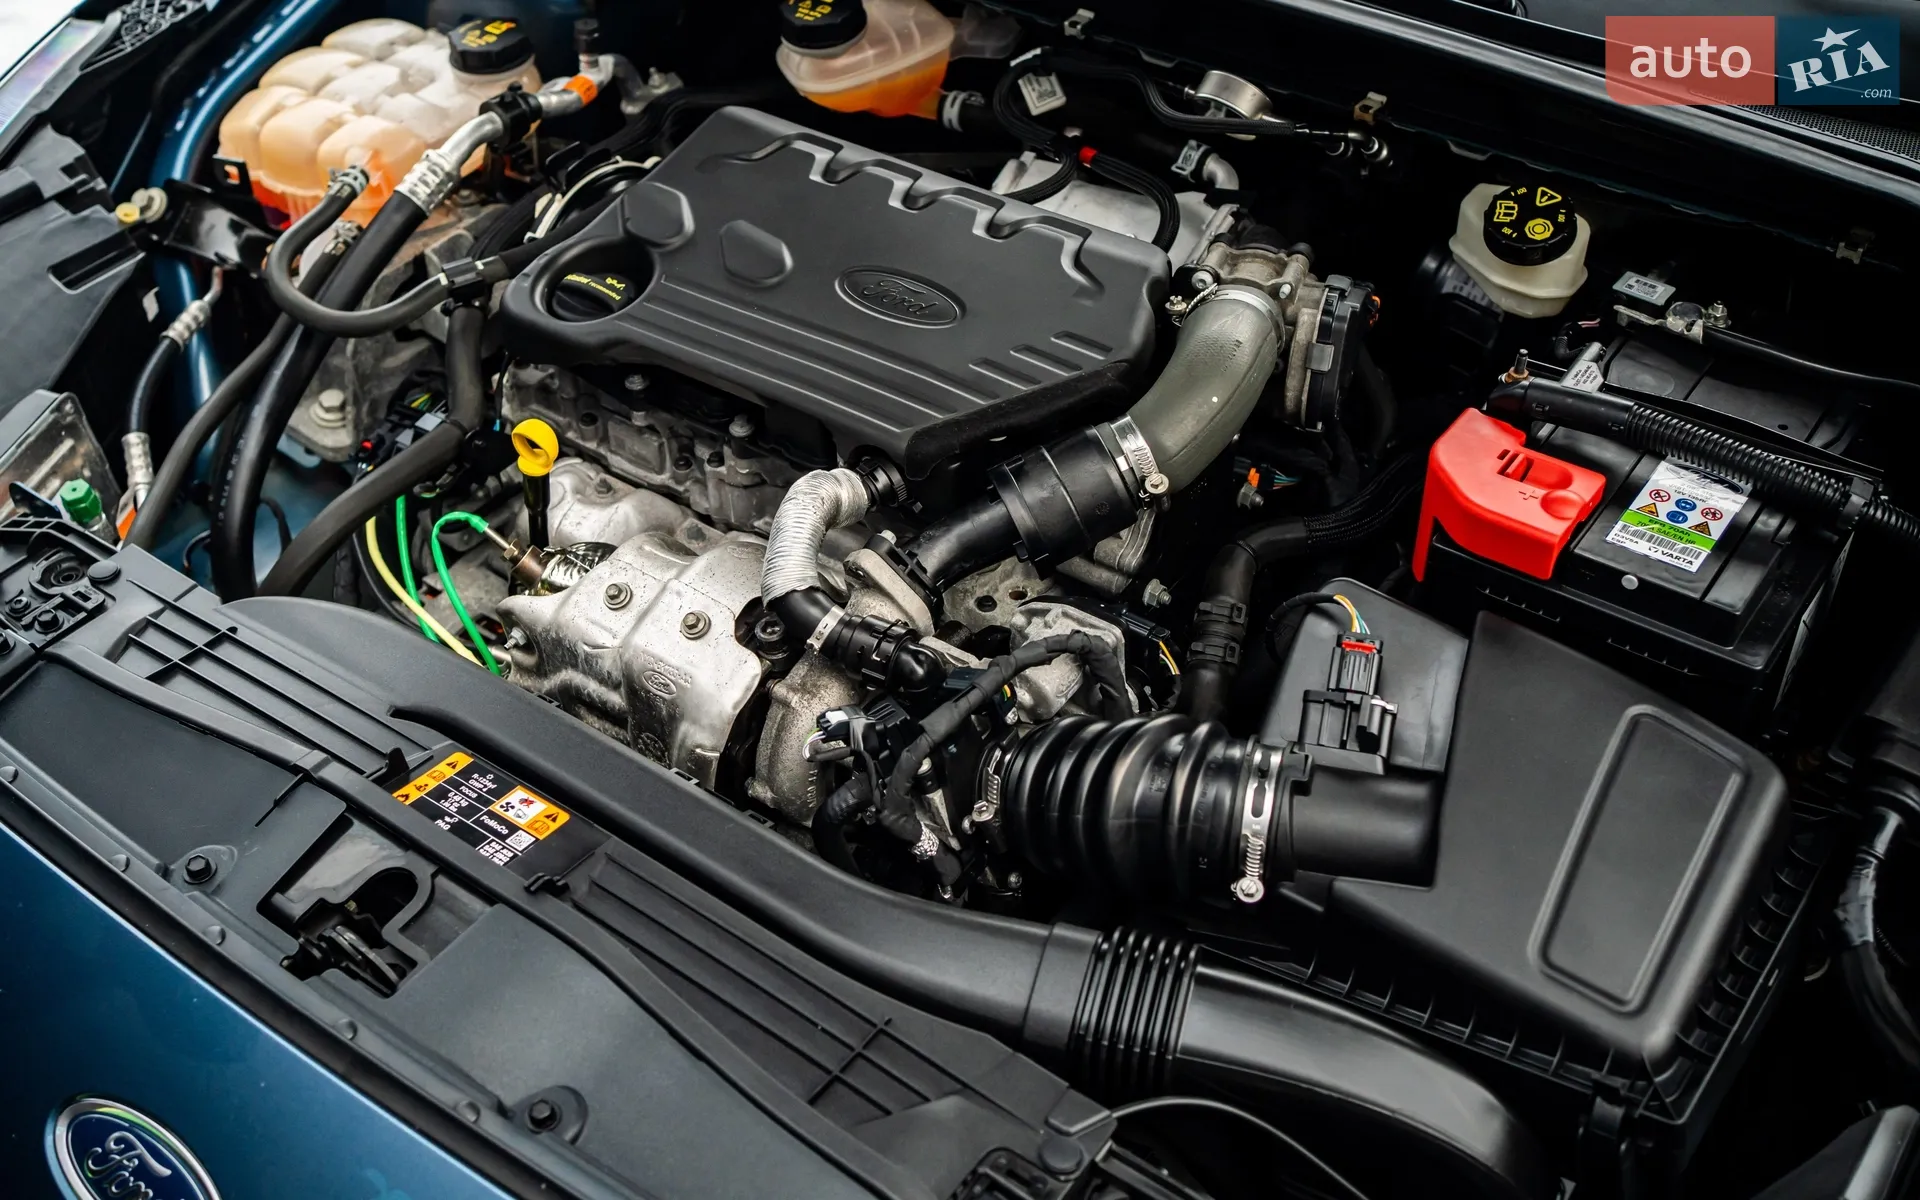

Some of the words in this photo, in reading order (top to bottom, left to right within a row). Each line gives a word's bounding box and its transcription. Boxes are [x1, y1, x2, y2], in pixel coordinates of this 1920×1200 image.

[861, 279, 939, 315] Ford
[1636, 520, 1655, 533] 70A
[1660, 549, 1695, 566] VARTA
[469, 779, 485, 788] GWP
[459, 786, 478, 799] FOCUS
[459, 799, 469, 807] kg
[434, 819, 451, 830] PAG
[480, 815, 509, 835] FoMoCo
[84, 1131, 186, 1200] For
